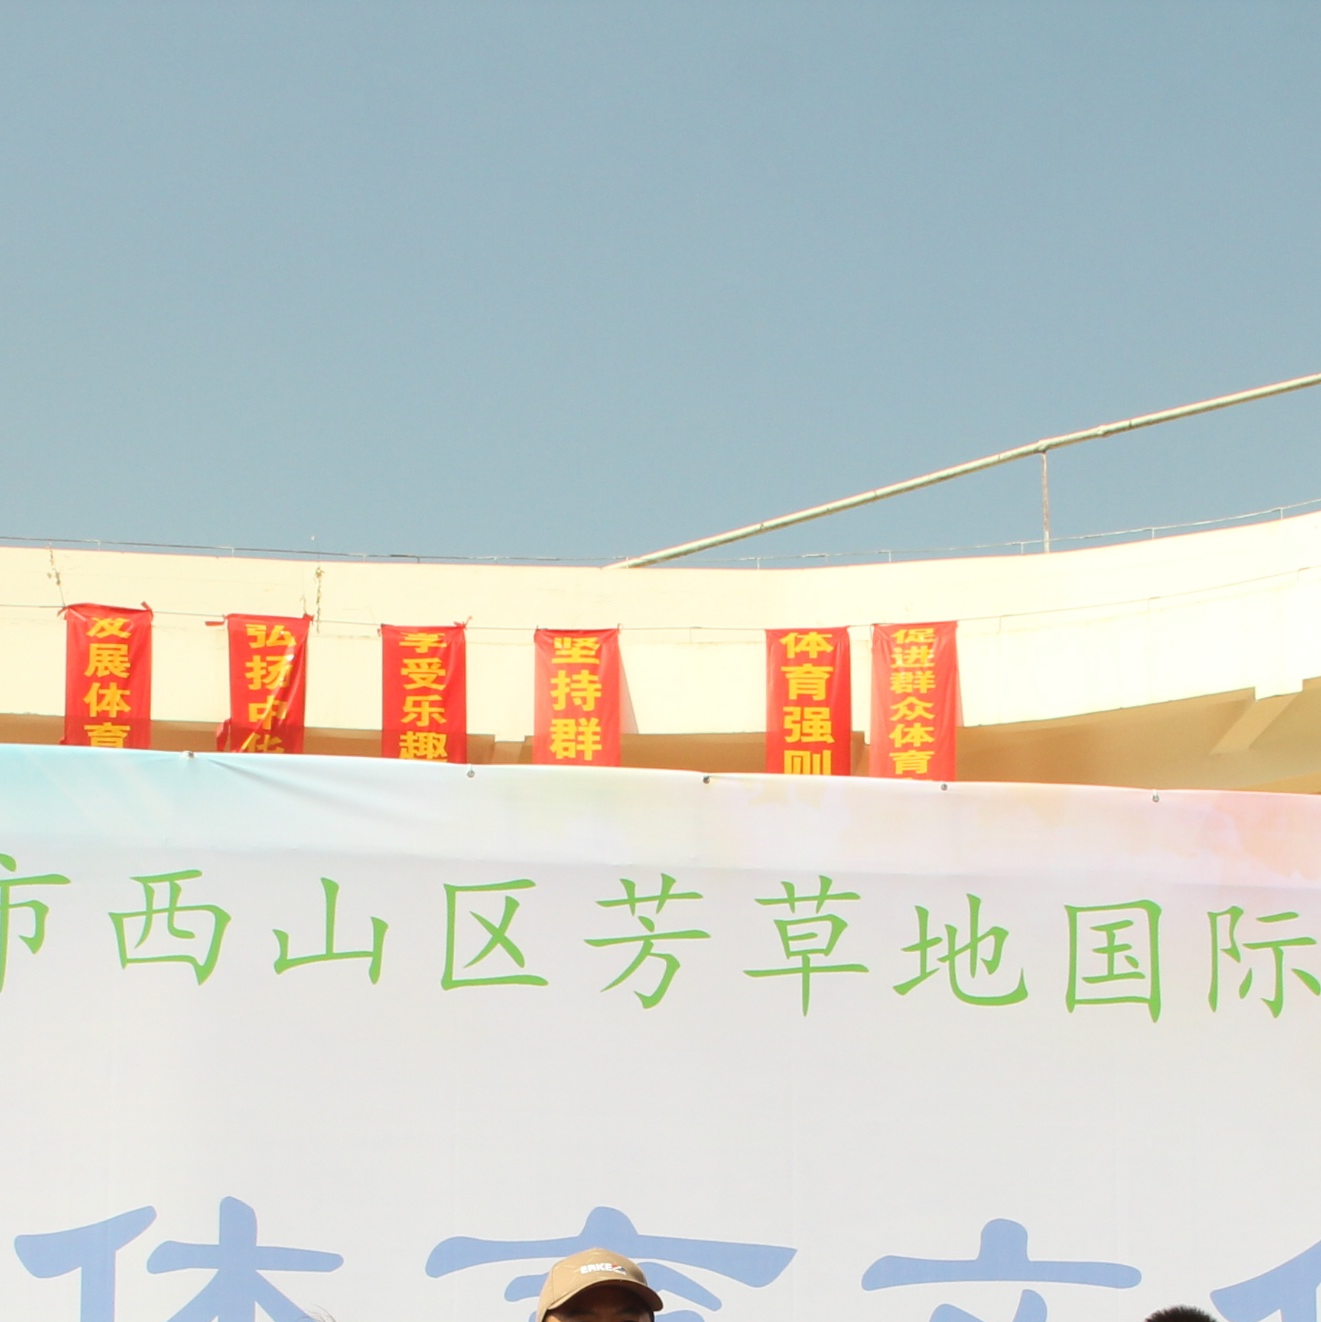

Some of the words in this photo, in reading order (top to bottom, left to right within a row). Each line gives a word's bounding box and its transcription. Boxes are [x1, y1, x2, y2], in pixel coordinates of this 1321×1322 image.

[550, 637, 602, 760] 坚持群
[889, 628, 936, 780] 促进群众体育
